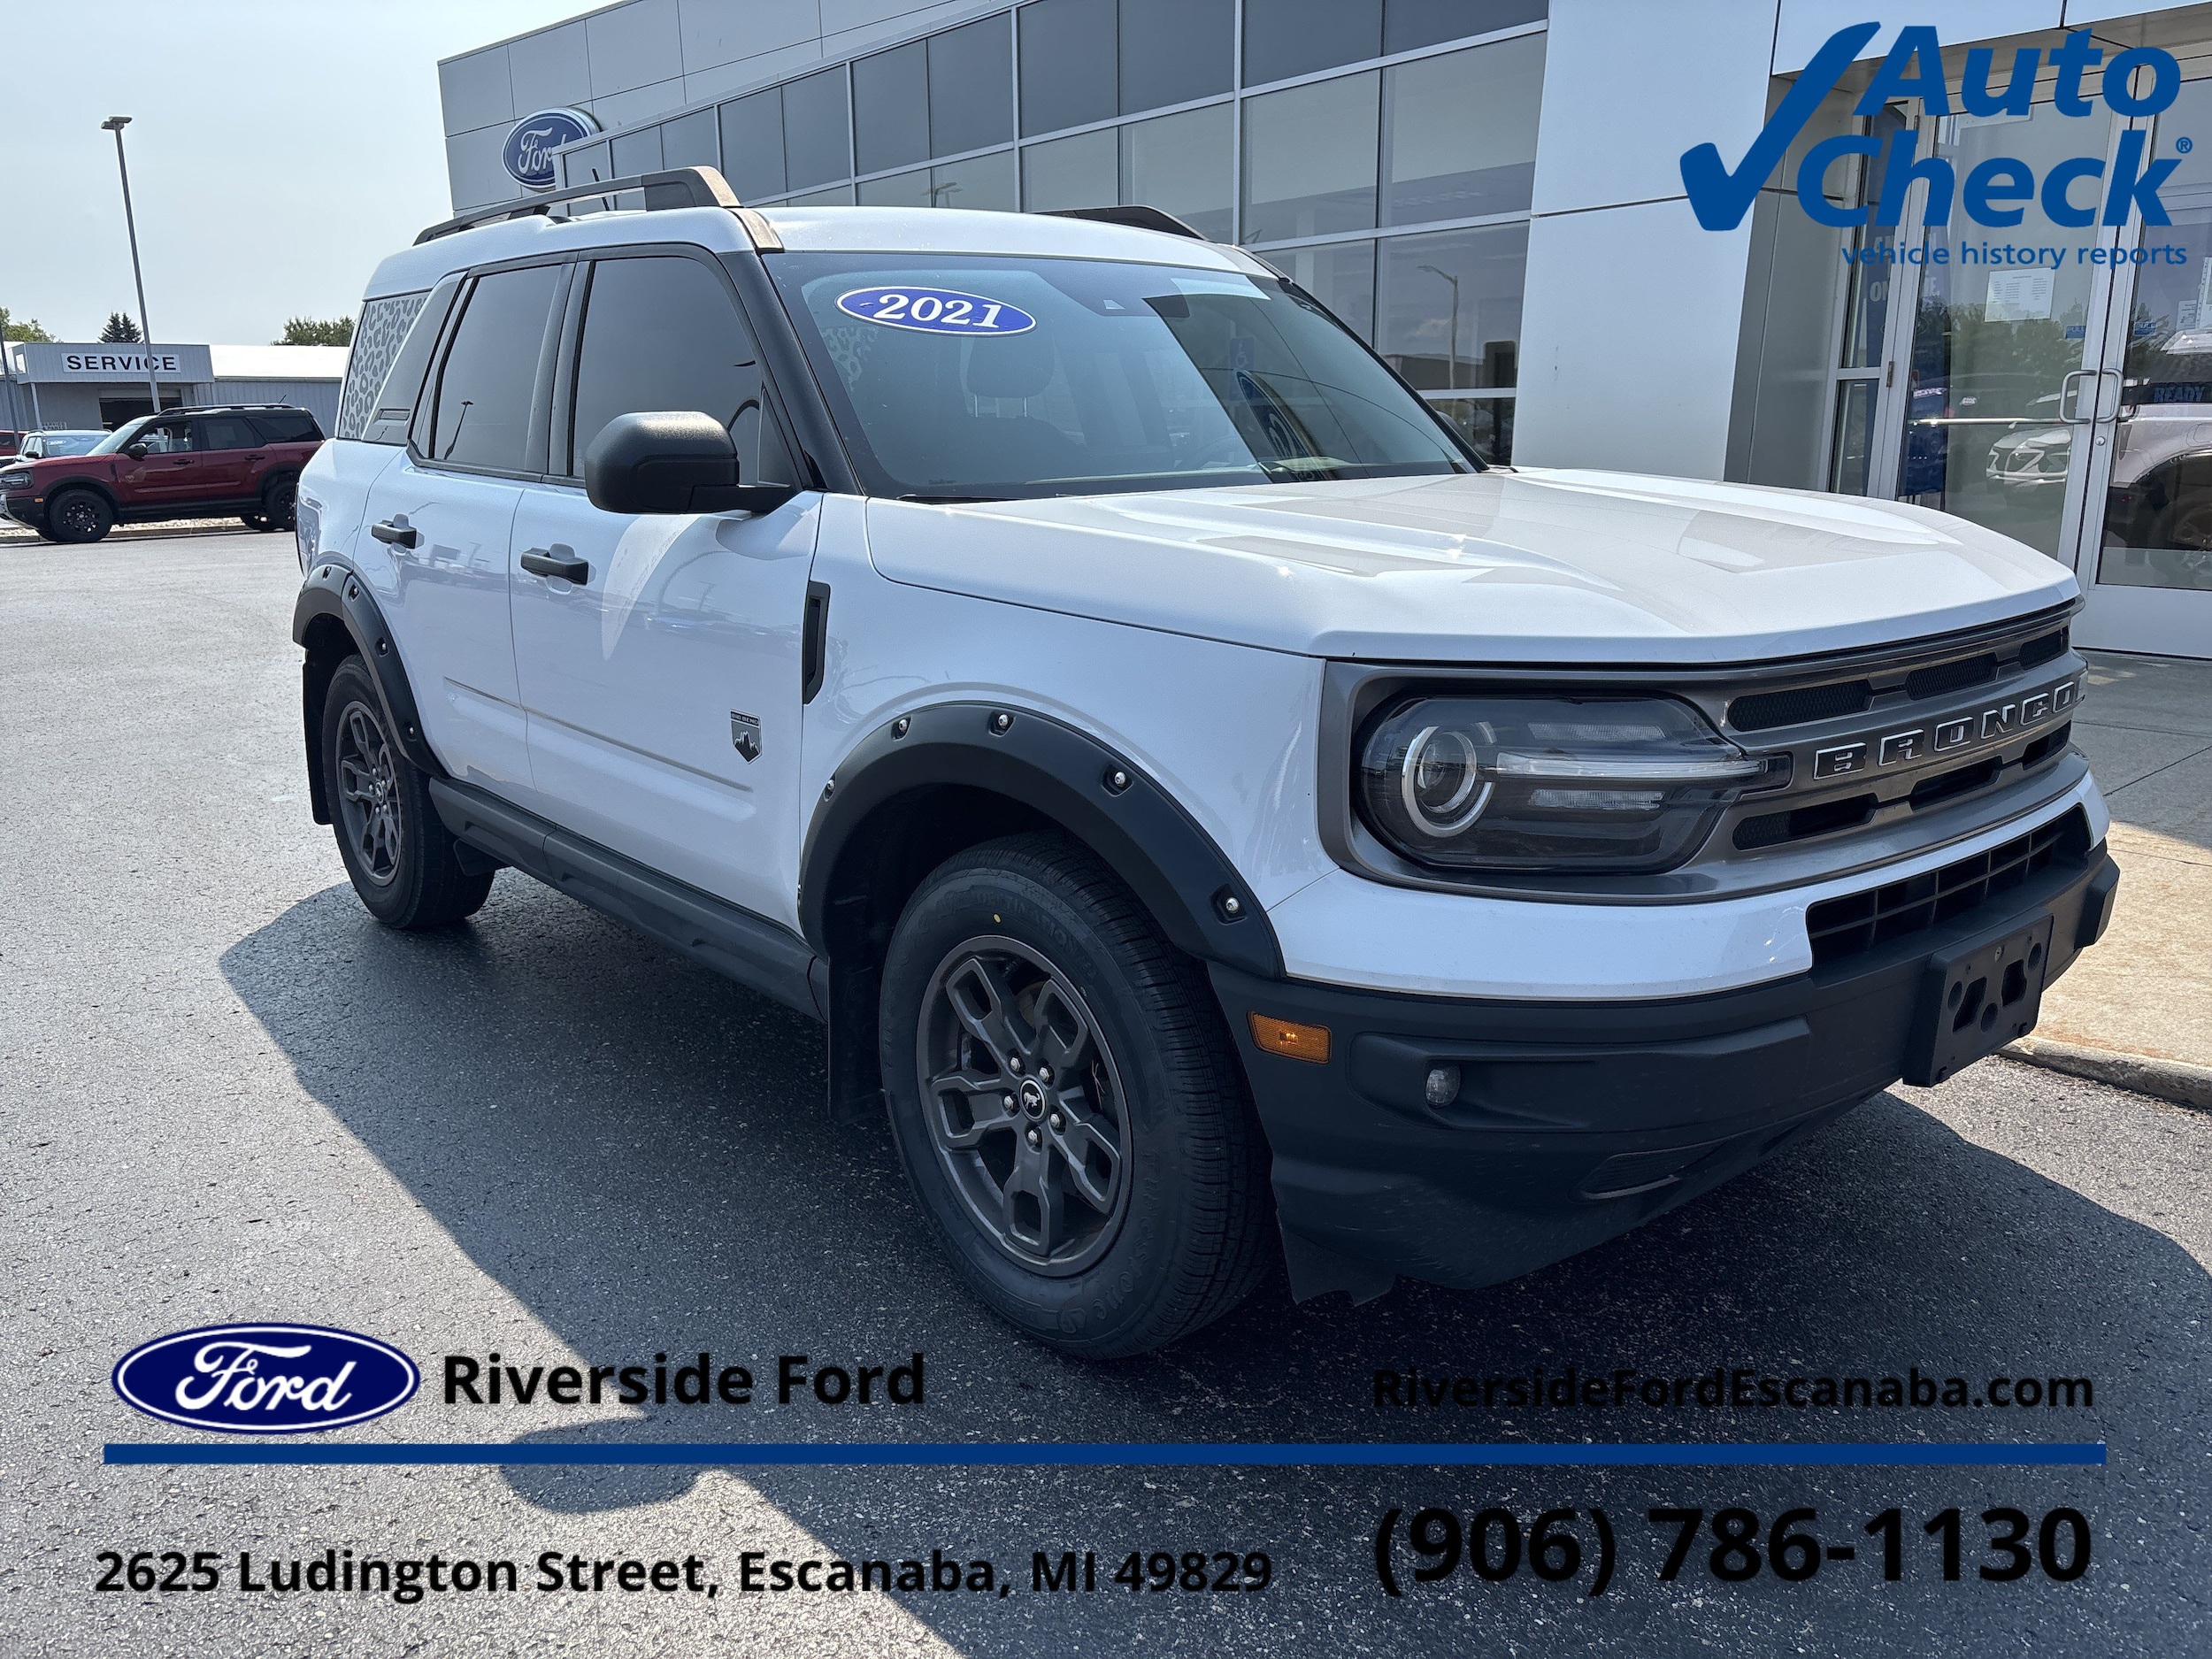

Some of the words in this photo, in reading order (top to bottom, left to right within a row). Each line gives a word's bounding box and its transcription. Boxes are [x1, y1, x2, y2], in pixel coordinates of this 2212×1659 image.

[518, 127, 566, 174] For
[873, 294, 1002, 328] 2021
[66, 356, 176, 370] SERVICE
[1813, 680, 2076, 780] BRONCO
